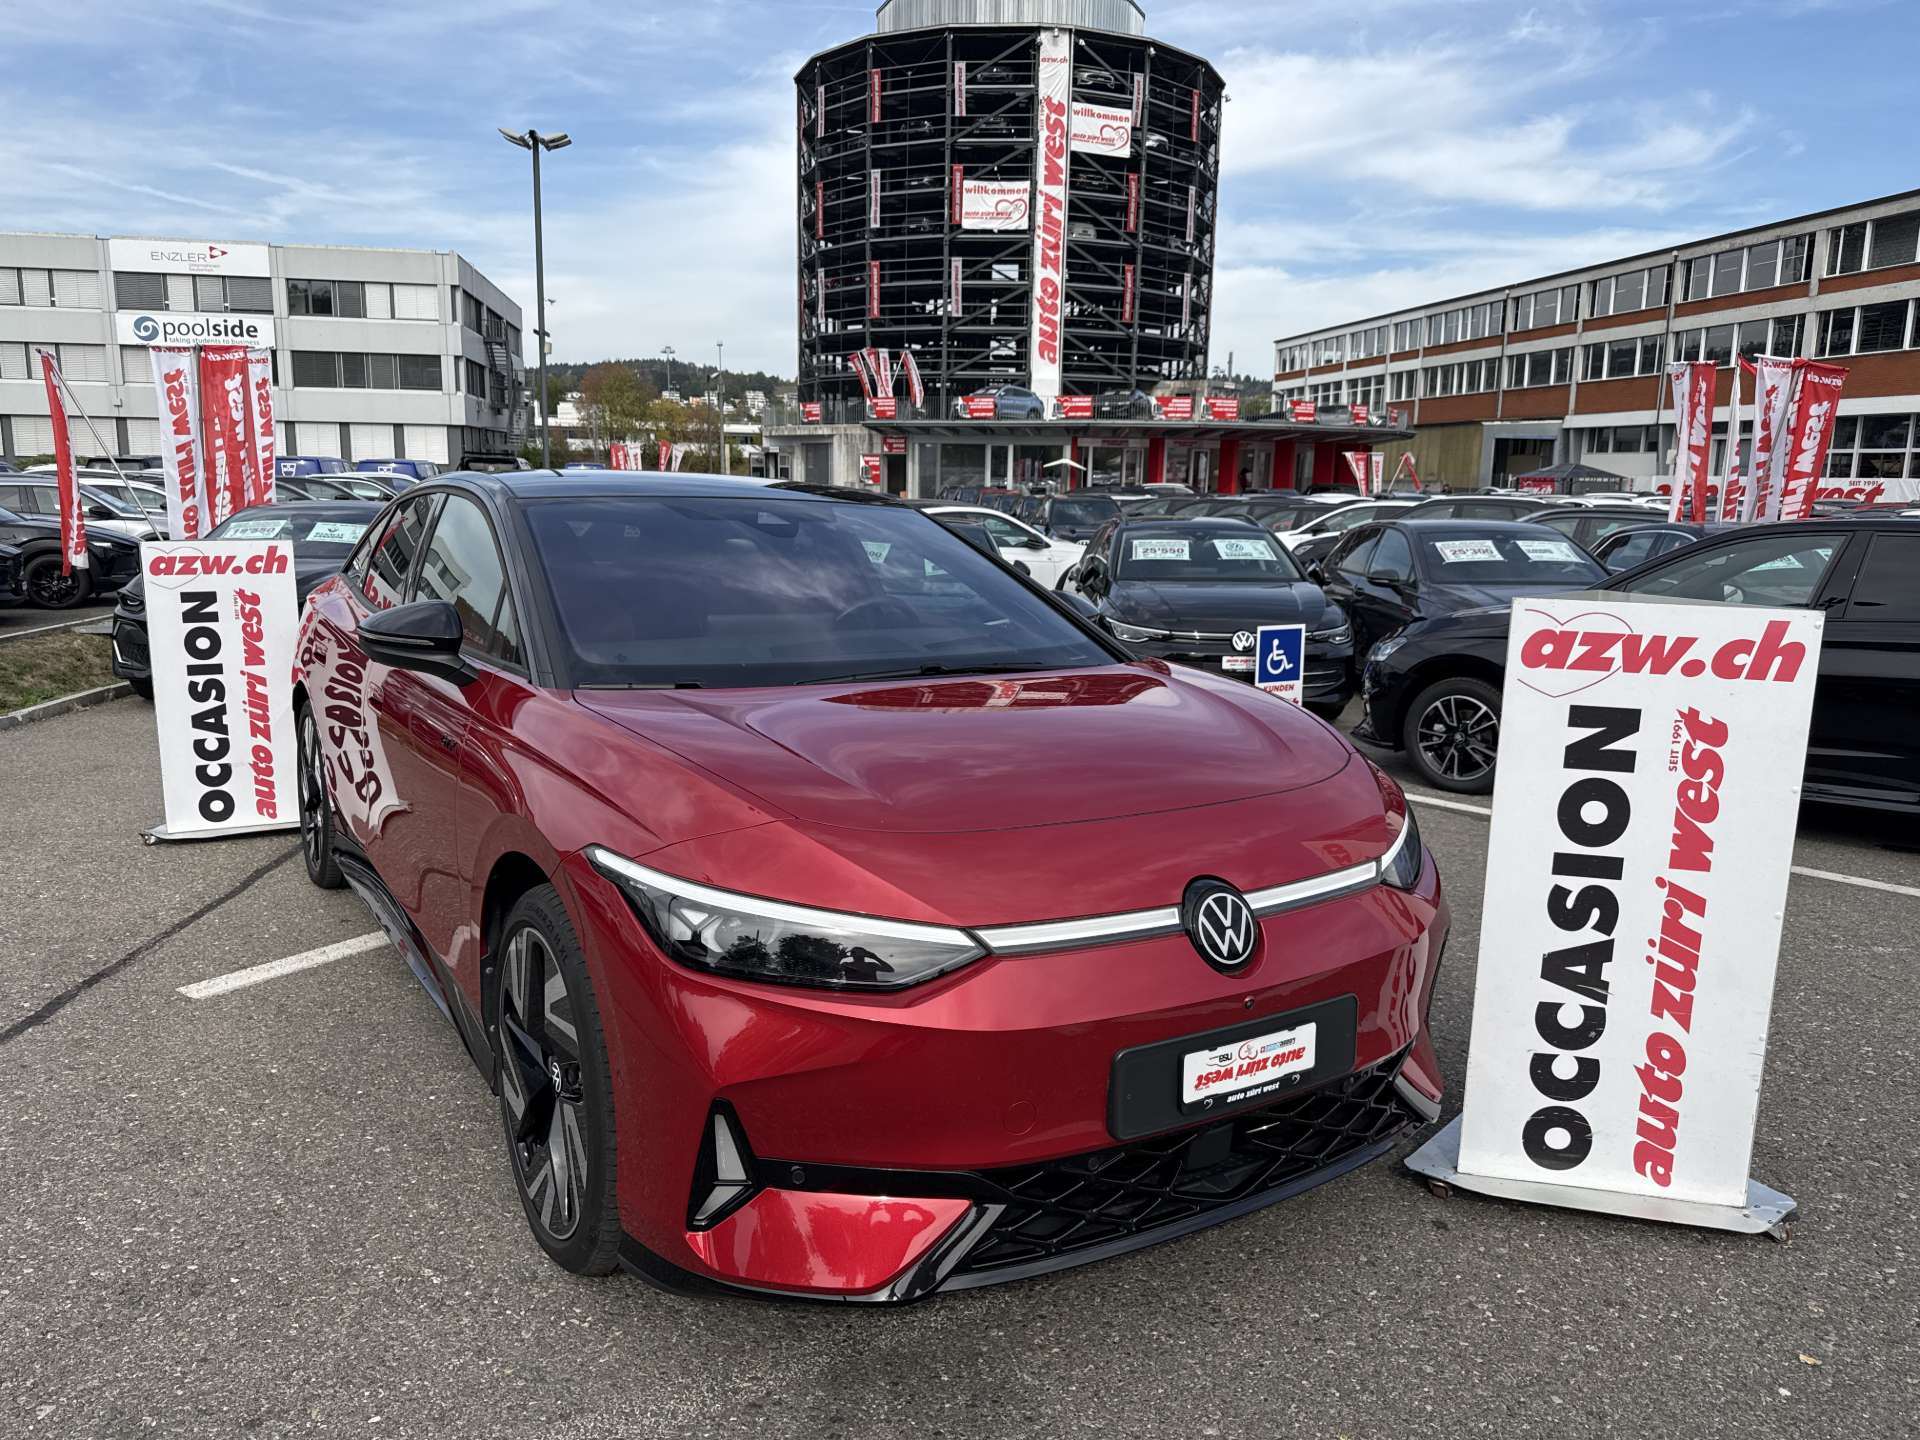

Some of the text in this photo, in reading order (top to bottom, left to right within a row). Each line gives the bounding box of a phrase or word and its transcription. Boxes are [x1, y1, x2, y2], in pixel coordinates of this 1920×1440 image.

[1041, 56, 1068, 64] azw.ch
[1073, 108, 1130, 122] willkommen
[964, 185, 1028, 195] willkommen
[1036, 95, 1068, 365] auto züri west
[151, 251, 208, 263] ENZLER
[163, 318, 259, 342] poolside
[169, 336, 191, 344] taking
[231, 338, 260, 346] business
[149, 546, 288, 576] azw.ch
[1520, 620, 1806, 682] azw.ch
[1264, 684, 1294, 692] KUNDEN
[180, 590, 236, 822] OCCASION
[235, 588, 278, 820] auto züri west
[1668, 719, 1683, 772] SEIT 1991
[1522, 704, 1642, 1171] OCCASION
[1632, 706, 1728, 1188] auto züri west
[1236, 1056, 1271, 1080] züri
[1270, 1046, 1306, 1068] auto
[1194, 1066, 1234, 1090] west
[1226, 1093, 1245, 1103] auto
[1262, 1082, 1280, 1092] west
